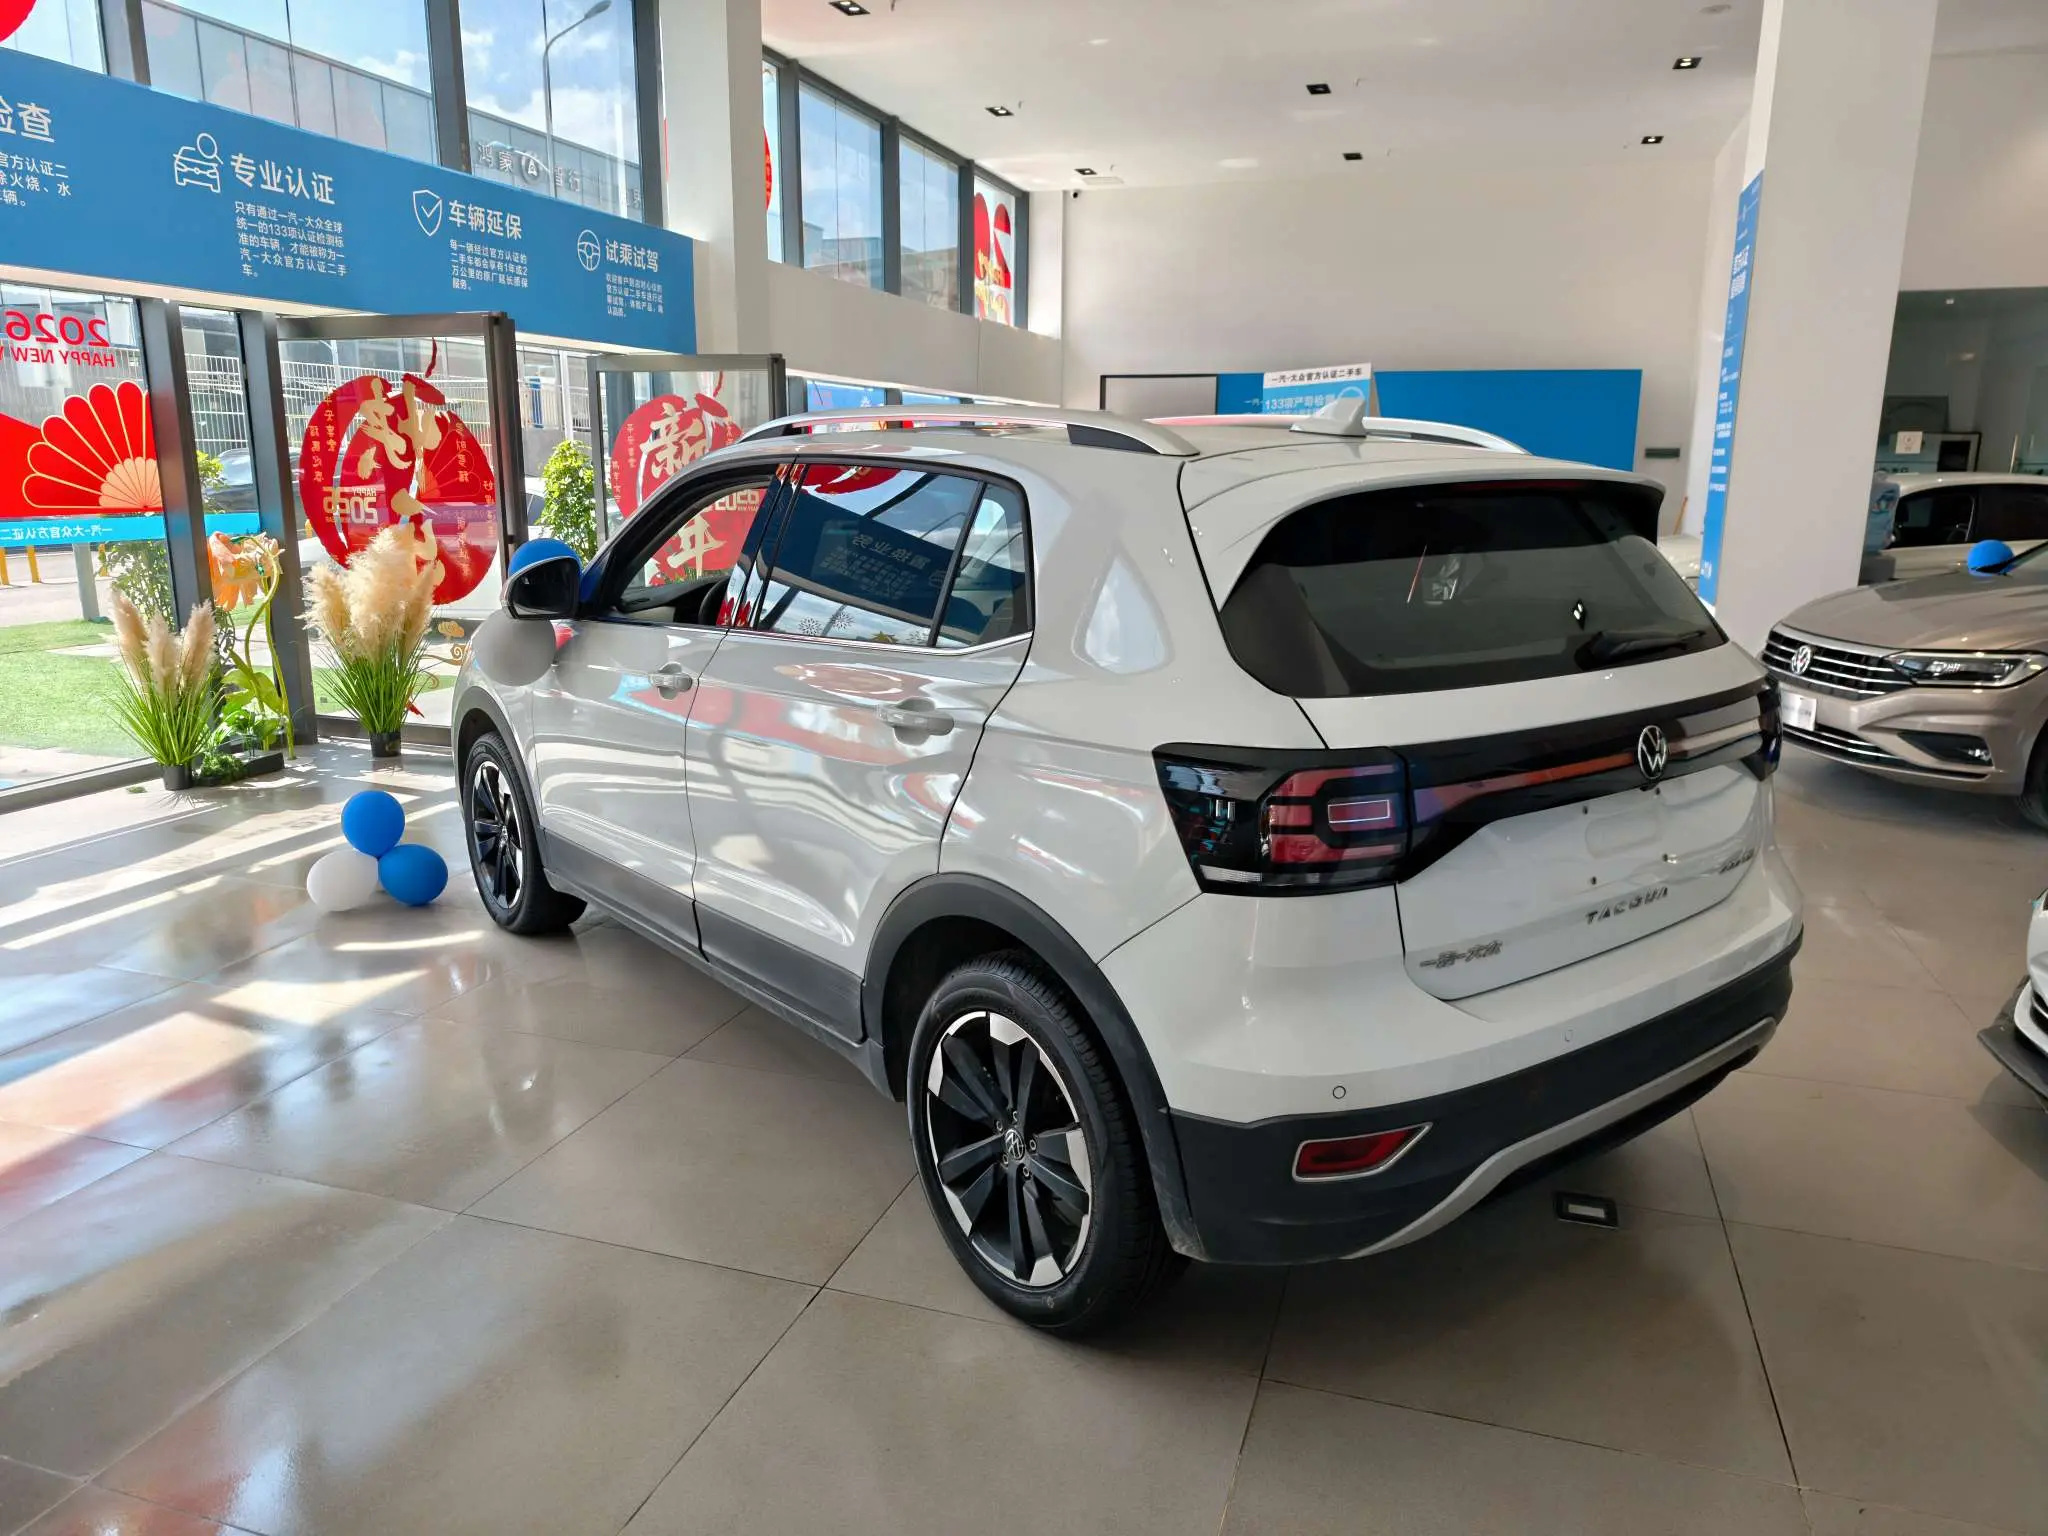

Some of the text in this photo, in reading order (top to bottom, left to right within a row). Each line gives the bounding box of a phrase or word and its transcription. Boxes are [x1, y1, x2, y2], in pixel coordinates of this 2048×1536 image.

[230, 153, 336, 205] 专业认证
[236, 216, 345, 248] 统一的133项认证检测标
[448, 199, 522, 240] 车辆延保
[606, 238, 659, 273] 试乘试驾
